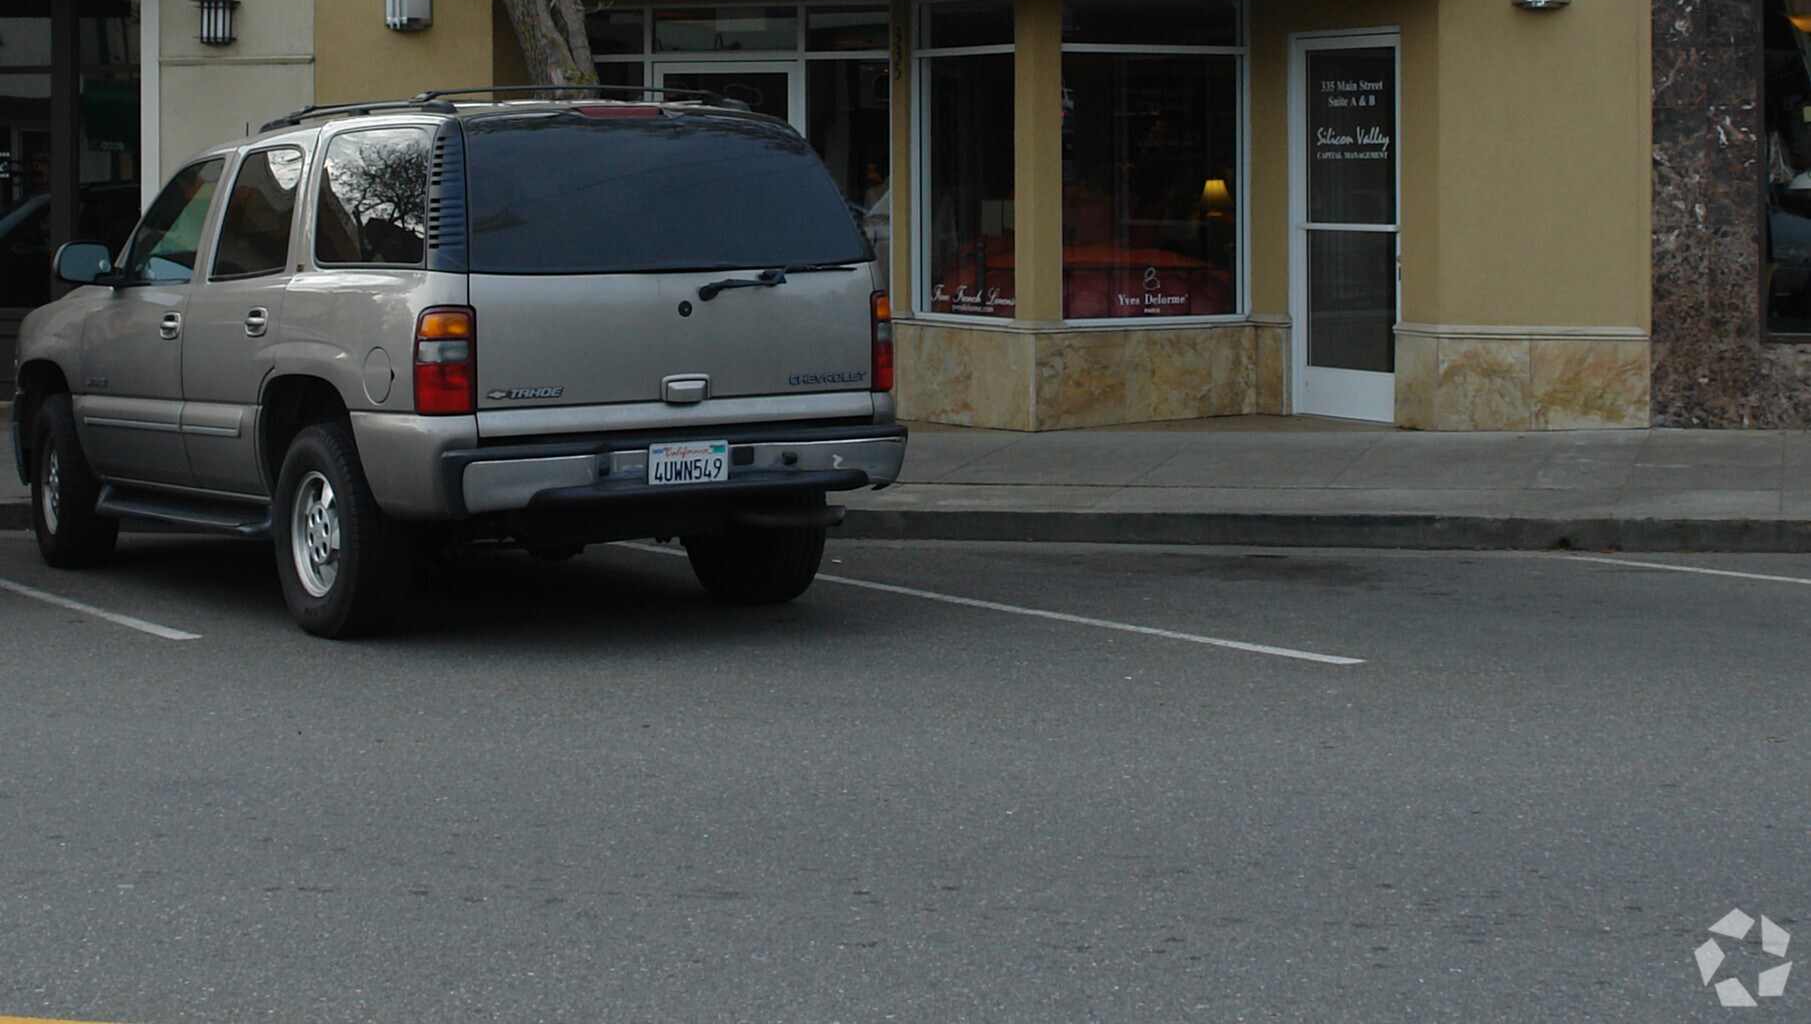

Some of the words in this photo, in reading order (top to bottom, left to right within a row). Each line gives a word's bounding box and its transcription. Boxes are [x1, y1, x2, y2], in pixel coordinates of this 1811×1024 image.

[1321, 80, 1335, 92] 335
[1336, 80, 1358, 91] Main
[1359, 79, 1383, 91] Street
[1328, 96, 1348, 107] Suite
[1350, 96, 1357, 106] A
[1358, 95, 1366, 106] &
[1368, 95, 1376, 106] B
[1316, 126, 1354, 146] Silicon
[1355, 125, 1390, 152] Valley
[1316, 151, 1342, 159] CAPITAL
[1343, 151, 1389, 160] MANAGEMENT
[1118, 293, 1141, 306] Yves
[788, 371, 866, 386] CHEVROLET
[509, 387, 564, 400] TAHOE
[663, 445, 713, 459] California
[654, 458, 723, 483] 4UWN549
